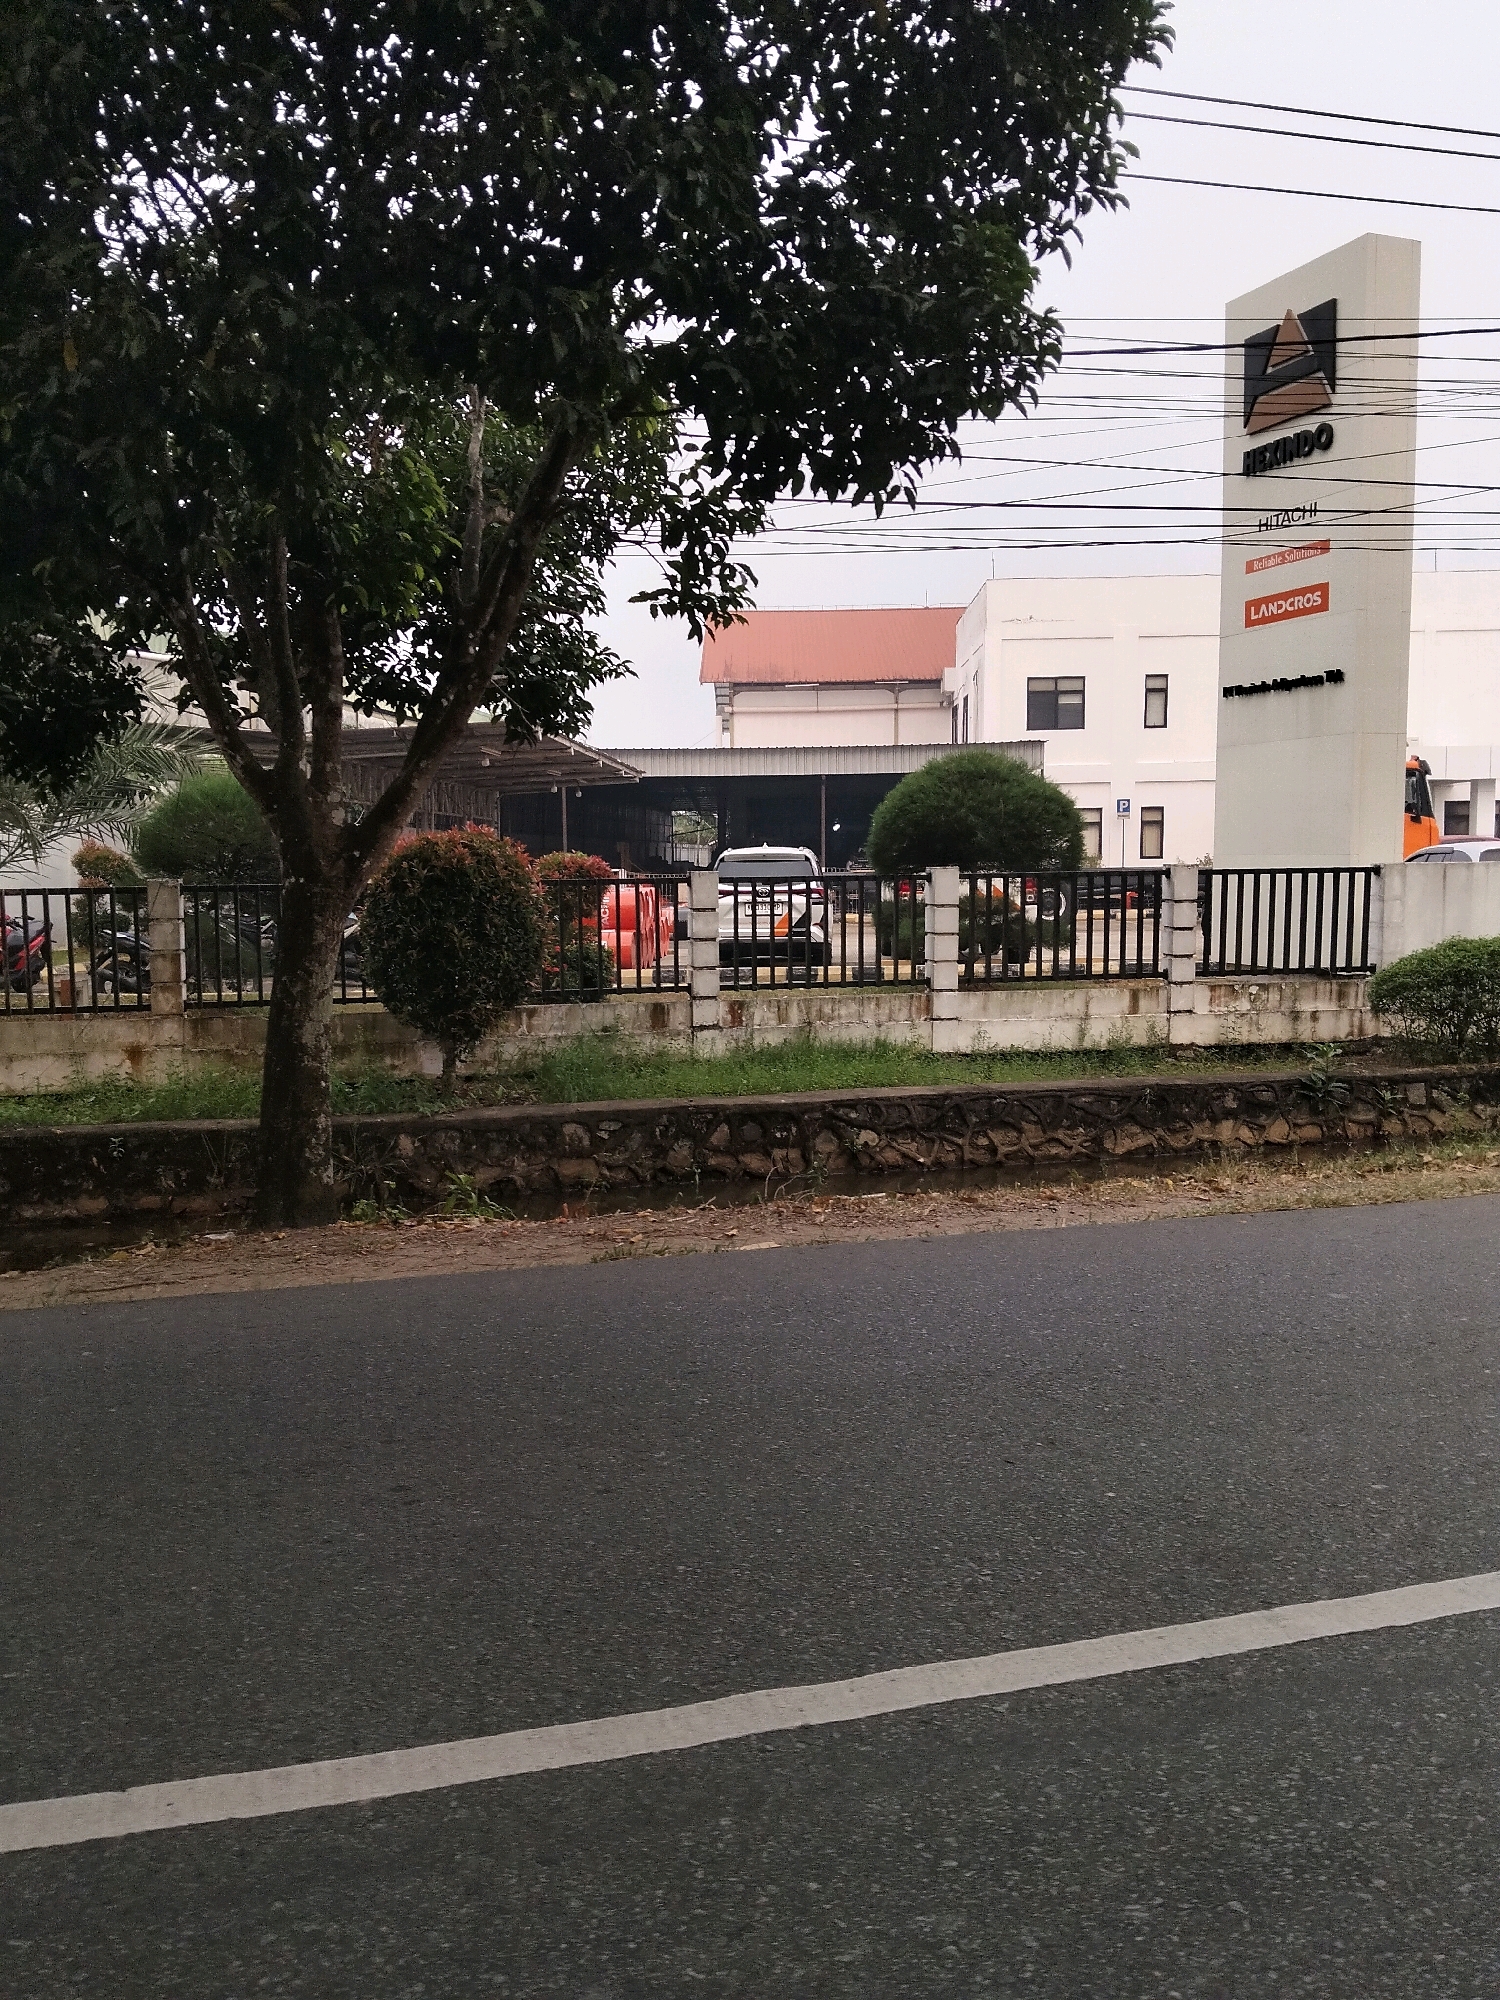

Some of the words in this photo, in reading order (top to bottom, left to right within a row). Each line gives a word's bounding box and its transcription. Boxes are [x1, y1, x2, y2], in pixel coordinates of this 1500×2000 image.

[1243, 423, 1333, 475] HEXINDO
[1259, 502, 1317, 532] HITACHI
[1253, 554, 1282, 571] Reliable
[1284, 545, 1321, 563] Solutions
[1250, 591, 1321, 620] LANDCROS
[1120, 801, 1128, 811] P
